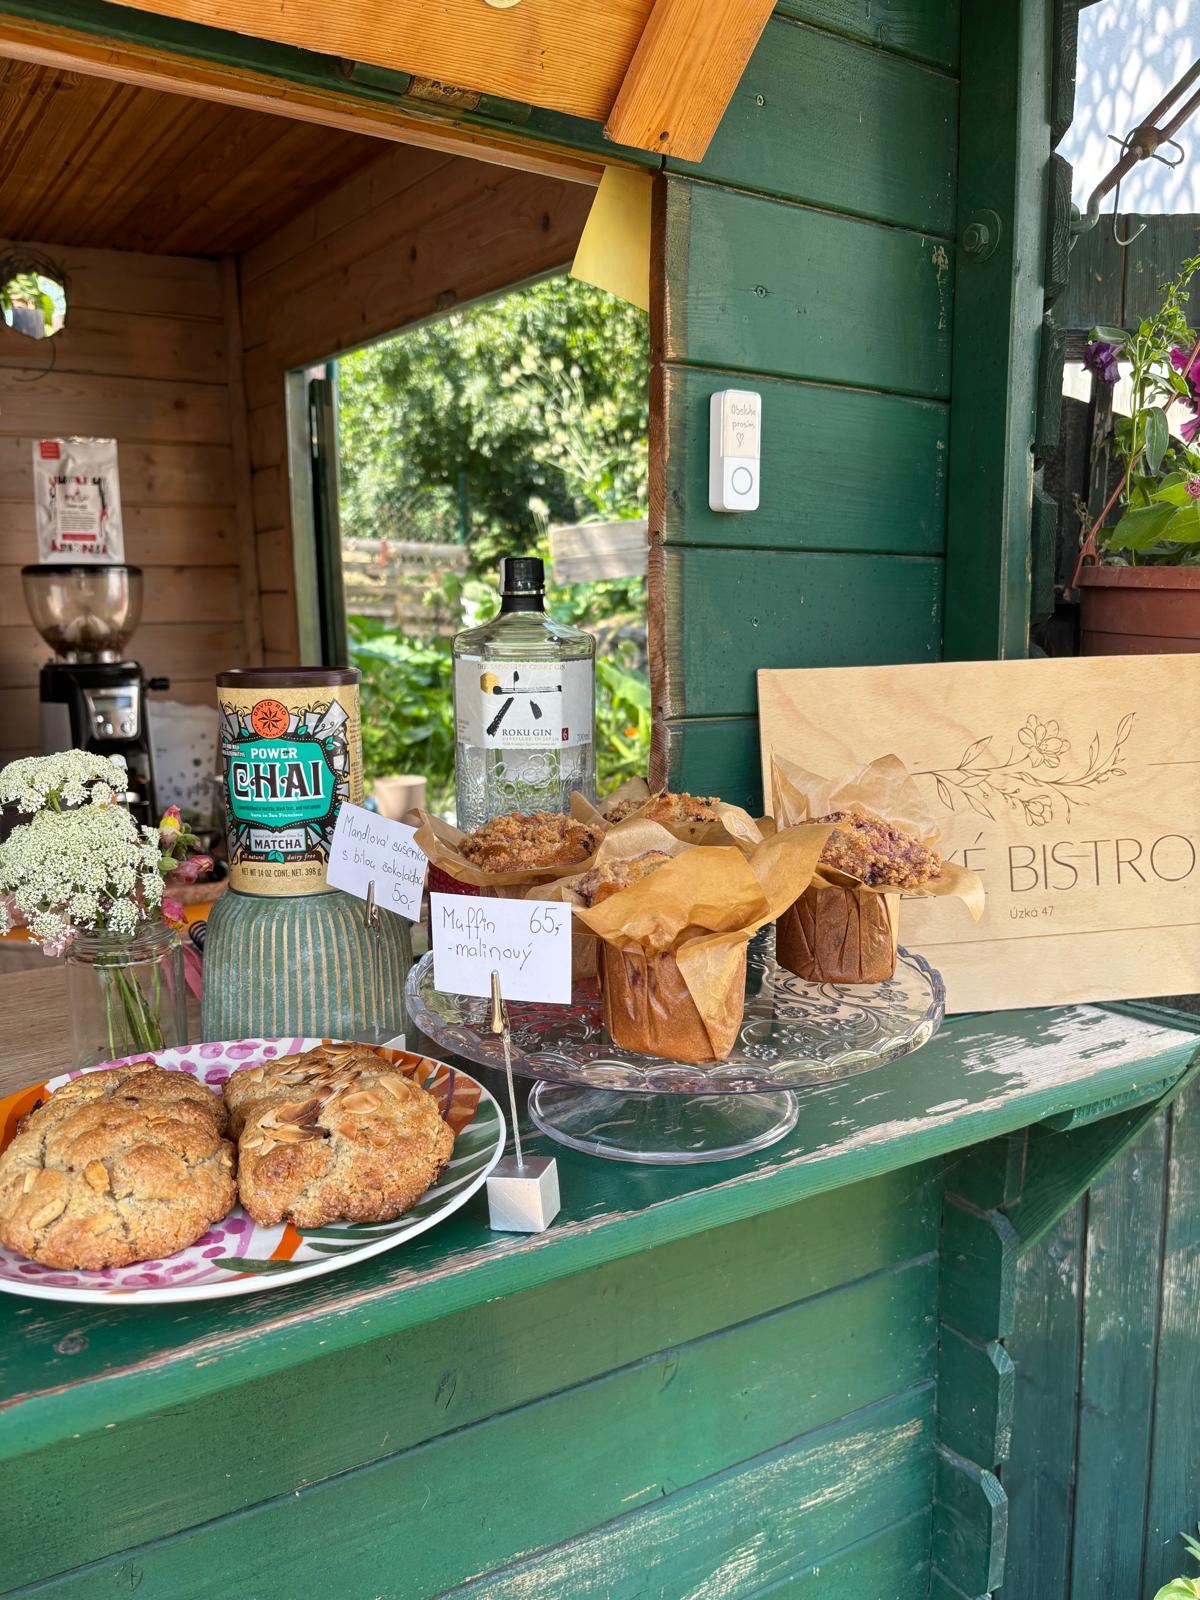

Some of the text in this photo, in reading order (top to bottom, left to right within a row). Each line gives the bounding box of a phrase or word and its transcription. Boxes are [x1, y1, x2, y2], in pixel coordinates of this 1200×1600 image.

[254, 702, 287, 717] DAVID RIO
[502, 729, 552, 737] ROKU GIN
[251, 748, 298, 760] POWER
[231, 760, 325, 802] CHAI
[254, 840, 302, 850] MATCHA
[1008, 834, 1196, 892] BISTRO
[1009, 905, 1055, 920] Úzká 47
